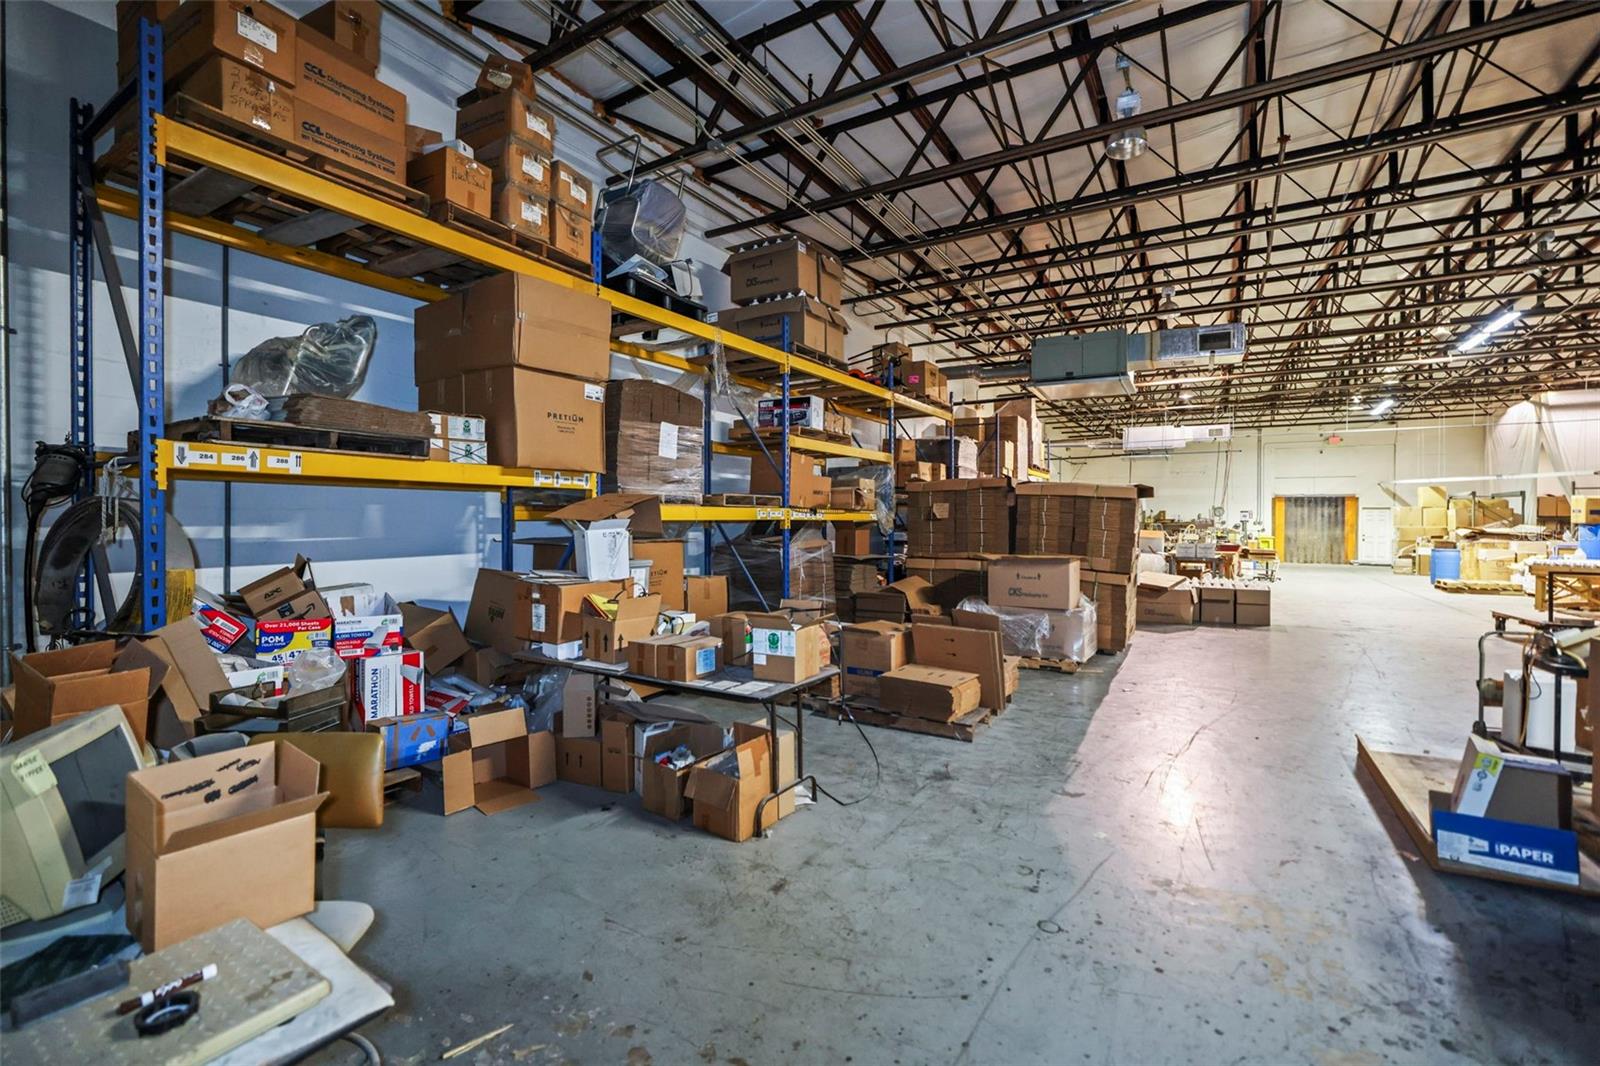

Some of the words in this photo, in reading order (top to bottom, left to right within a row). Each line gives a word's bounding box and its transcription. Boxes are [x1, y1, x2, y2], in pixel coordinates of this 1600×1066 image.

[303, 62, 326, 79] CCL
[327, 75, 367, 101] Dispensing
[367, 95, 395, 114] Systems
[301, 121, 325, 136] CCL
[325, 132, 367, 155] Dispensing
[367, 149, 396, 167] Systems
[547, 411, 584, 423] PRETIUM
[199, 452, 214, 460] 284
[264, 586, 282, 599] APC
[1008, 586, 1022, 597] CKS
[261, 635, 285, 644] POM
[271, 654, 284, 662] 45
[370, 667, 379, 719] MARATHON
[1499, 844, 1554, 865] PAPER
